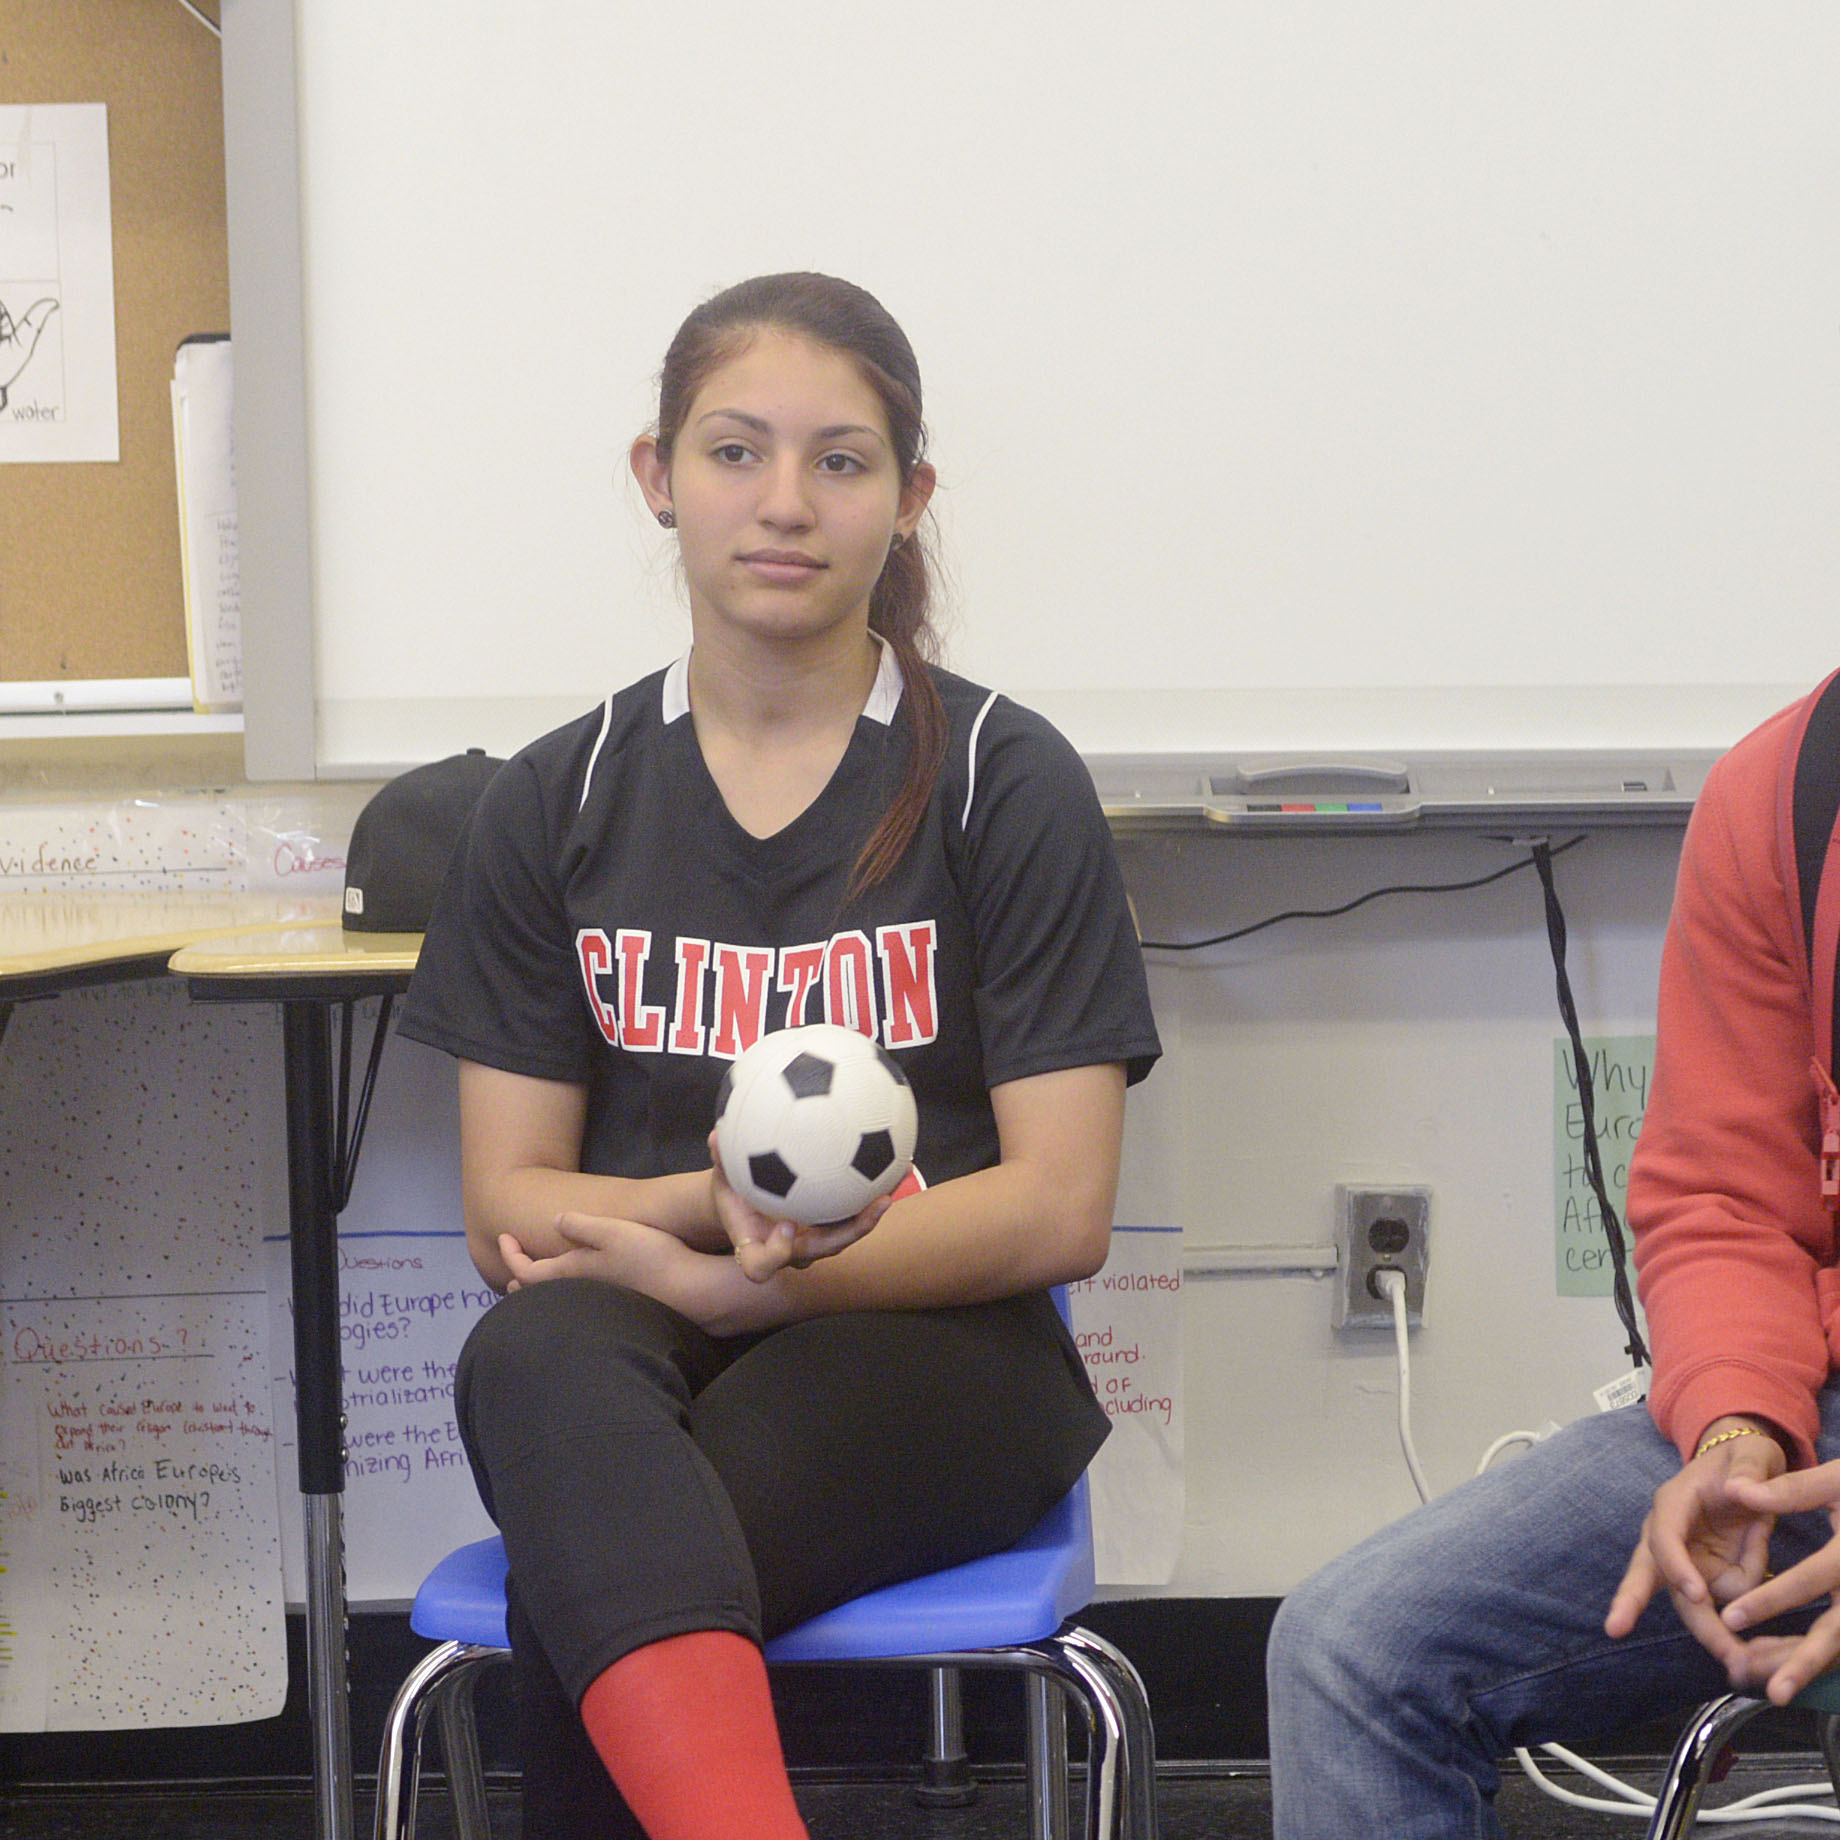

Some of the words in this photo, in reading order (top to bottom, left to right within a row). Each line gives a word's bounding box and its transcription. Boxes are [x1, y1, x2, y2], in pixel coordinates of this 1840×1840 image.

[274, 843, 346, 877] Causes
[576, 920, 938, 1061] CLINTON
[1563, 1048, 1646, 1111] Why
[1103, 1269, 1180, 1291] violated
[380, 1290, 455, 1317] Europe
[15, 1327, 162, 1361] Questions
[1075, 1326, 1113, 1347] and
[1084, 1343, 1145, 1364] round.
[358, 1366, 413, 1384] were
[1103, 1394, 1172, 1425] cluding
